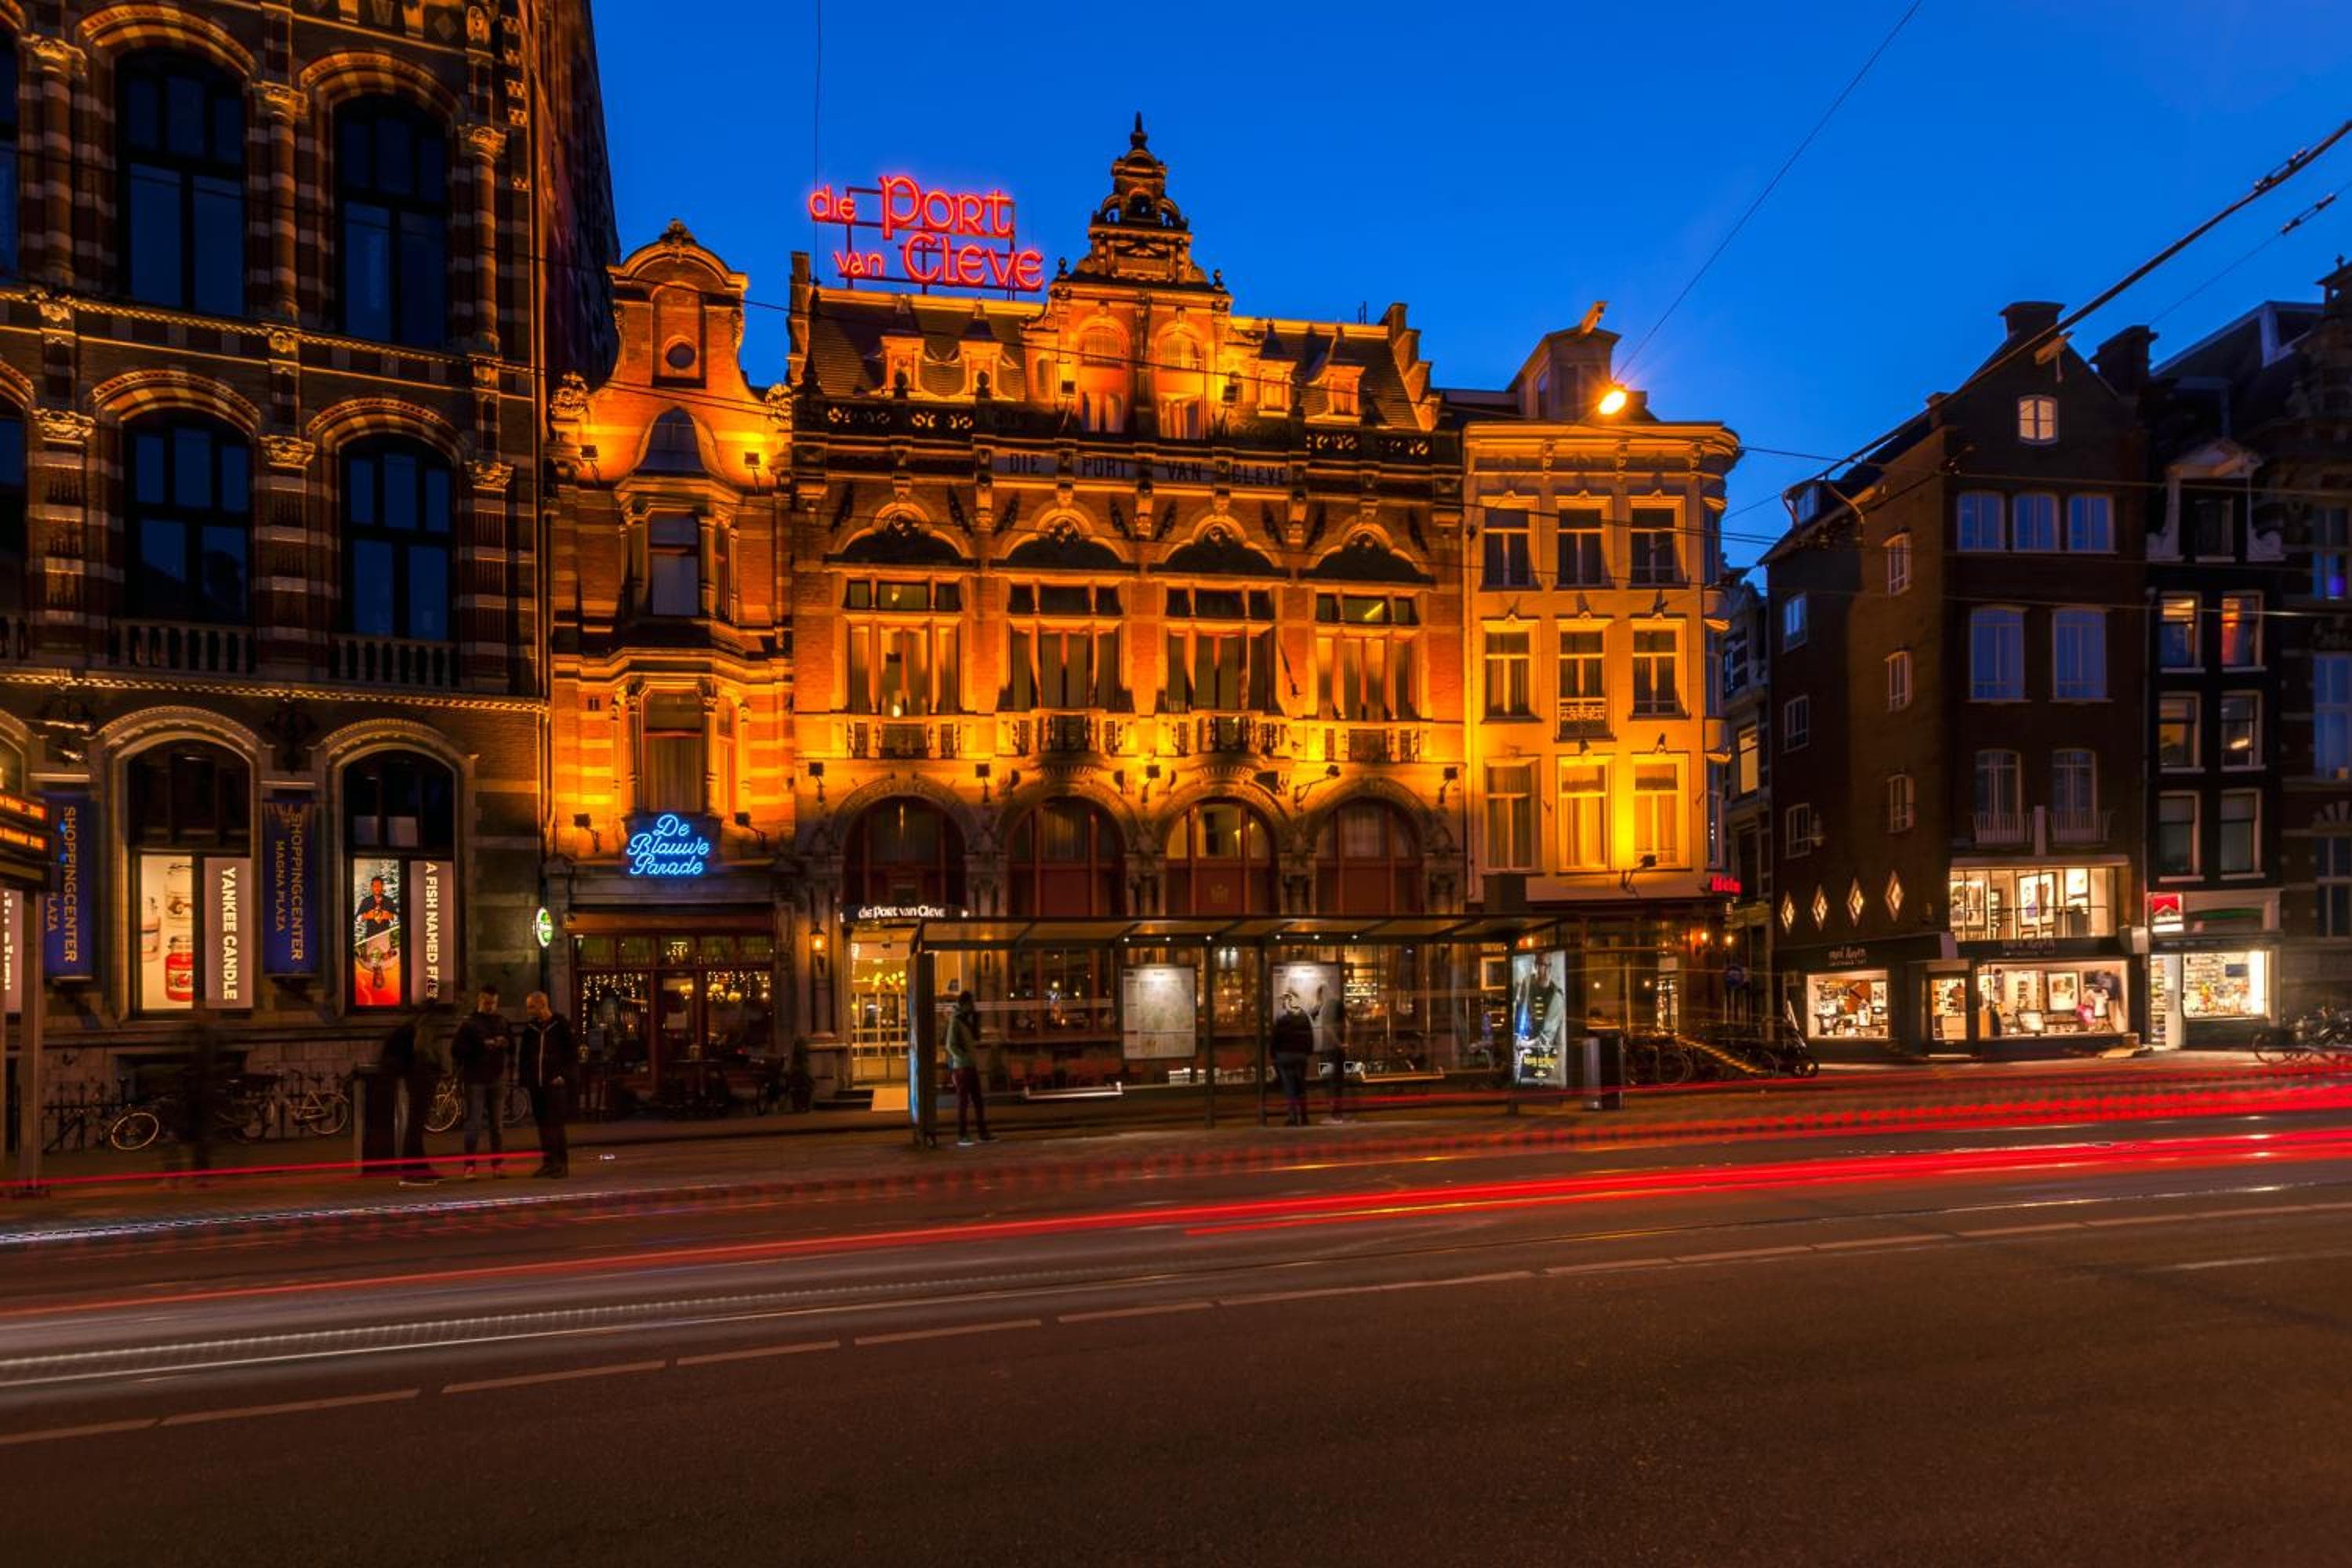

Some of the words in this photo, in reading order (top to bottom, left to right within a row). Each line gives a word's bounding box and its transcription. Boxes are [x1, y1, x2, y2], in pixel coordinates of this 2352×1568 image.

[834, 250, 884, 276] van
[902, 231, 1043, 290] Cleve
[1010, 453, 1041, 474] DIE
[1082, 457, 1125, 477] PORT
[1167, 461, 1200, 480] VAN
[1232, 465, 1287, 486] CLEVE
[627, 833, 709, 855] Blauwe
[652, 814, 690, 837] De
[64, 807, 77, 962] SHOPPINGCENTER
[276, 840, 285, 888] MAGNA
[426, 862, 437, 873] A
[630, 855, 703, 875] Parade
[222, 867, 237, 931] YANKEE
[291, 812, 303, 960] SHOPPINGCENTER
[426, 877, 438, 908] FISH
[276, 890, 285, 931] PLAZA
[899, 906, 916, 916] van
[426, 912, 438, 964] NAMED
[223, 935, 238, 1000] CANDLE
